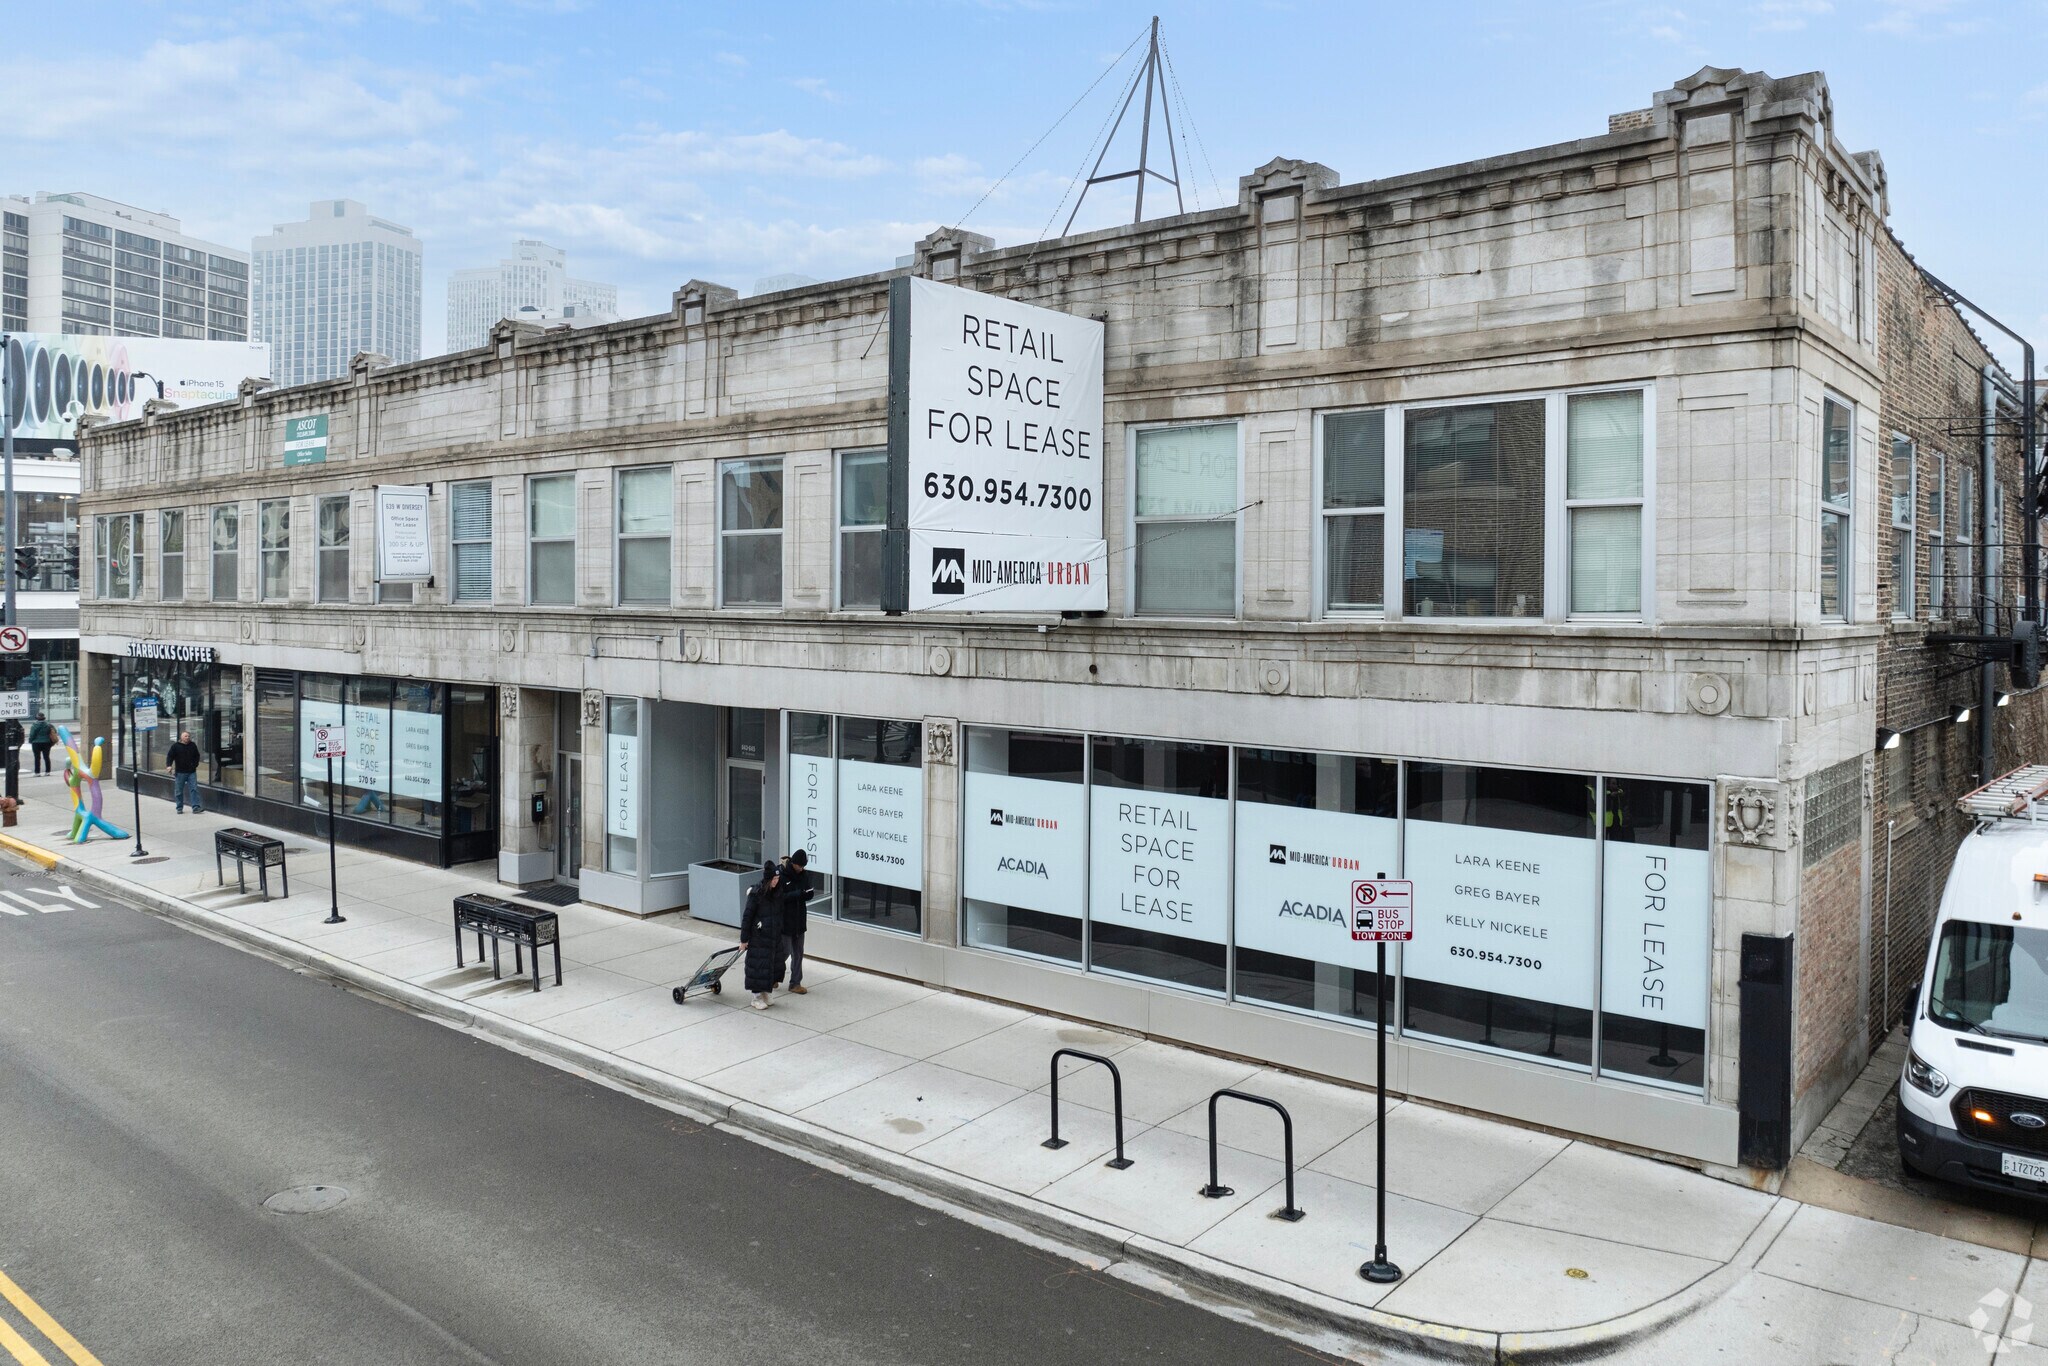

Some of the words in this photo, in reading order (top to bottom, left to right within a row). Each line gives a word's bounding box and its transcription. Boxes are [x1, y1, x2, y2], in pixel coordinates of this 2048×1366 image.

[963, 314, 1063, 363] RETAIL
[164, 388, 236, 400] Snaptacular
[968, 365, 1060, 408] SPACE
[296, 419, 317, 431] ASCOT
[928, 408, 992, 447] FOR
[1006, 419, 1090, 460] LEASE
[924, 472, 1091, 511] 630.954.7300
[972, 560, 1041, 584] MID-AMERICA
[1048, 562, 1089, 585] URBAN
[127, 642, 176, 660] STARBUCKS
[177, 646, 212, 662] COFFEE
[356, 711, 380, 724] RETAIL
[356, 727, 379, 740] SPACE
[360, 744, 375, 755] FOR
[356, 760, 379, 772] LEASE
[807, 762, 818, 799] FOR
[857, 784, 876, 793] LARA
[879, 786, 903, 796] KEENE
[857, 806, 877, 816] GREG
[880, 809, 903, 819] BAYER
[1006, 814, 1035, 826] MID-AMERICA
[1037, 818, 1057, 830] URBAN
[1119, 802, 1197, 831] RETAIL
[806, 806, 817, 865] LEASE
[853, 828, 874, 838] KELLY
[876, 832, 908, 844] NICKELE
[856, 850, 905, 866] 630.954.7300
[1121, 833, 1194, 862] SPACE
[997, 856, 1048, 880] ACADIA
[1290, 851, 1328, 866] MID-AMERICA
[1332, 857, 1359, 870] URBAN
[1455, 854, 1490, 868] LARA
[1496, 859, 1540, 874] KEENE
[1134, 865, 1180, 890] FOR
[1644, 855, 1666, 912] FOR
[1455, 885, 1490, 899] GREG
[1496, 890, 1540, 906] BAYER
[1121, 892, 1193, 923] LEASE
[1279, 900, 1347, 928] ACADIA
[1378, 910, 1399, 919] BUS
[1378, 920, 1404, 929] STOP
[1446, 915, 1486, 930] KELLY
[1490, 920, 1548, 940] NICKELE
[1450, 946, 1542, 970] 630.954.7300
[1642, 922, 1665, 1010] LEASE
[2012, 1161, 2045, 1177] 172725
